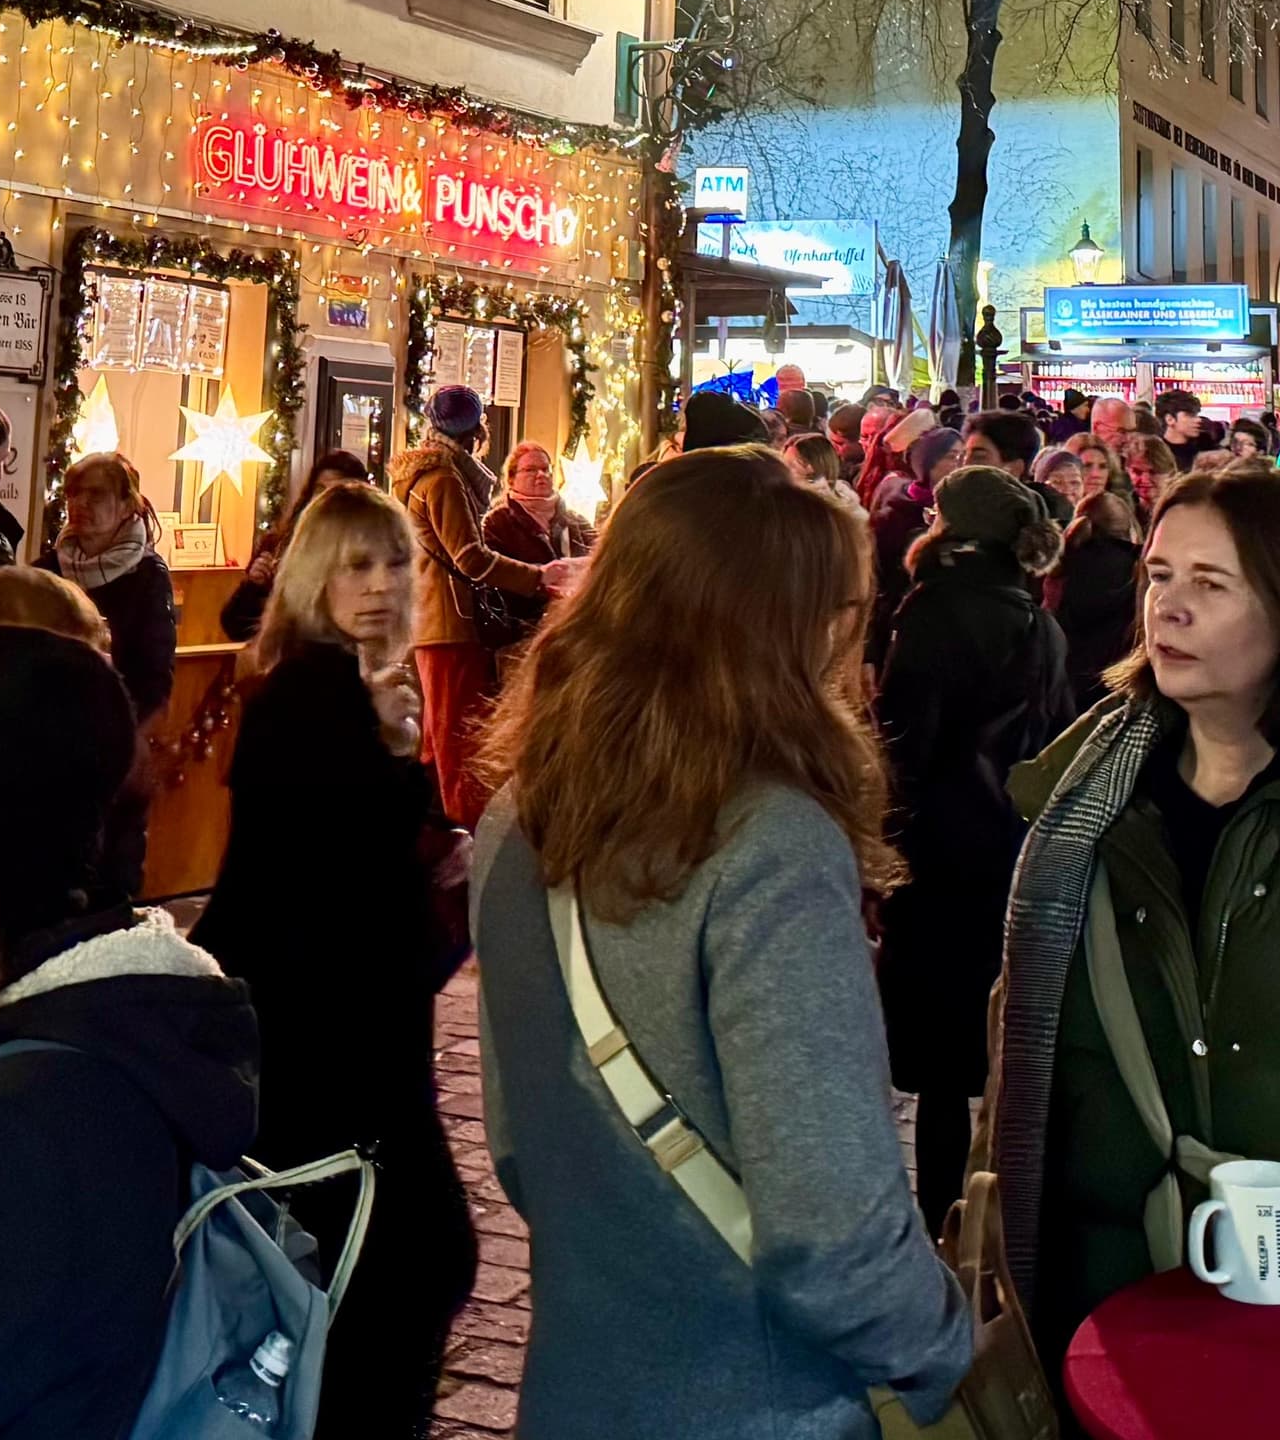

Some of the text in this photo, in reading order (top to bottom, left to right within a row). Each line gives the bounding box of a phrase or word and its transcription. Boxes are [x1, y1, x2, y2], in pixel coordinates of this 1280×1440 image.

[202, 123, 403, 214] GLÜHWEIN
[700, 176, 744, 193] ATM
[783, 247, 866, 265] Ofenkartoffel
[15, 292, 27, 307] 18
[1080, 299, 1097, 309] Die
[1099, 298, 1132, 309] besten
[1081, 307, 1234, 319] KÄSEKRAINER UND LEBERKÄSE
